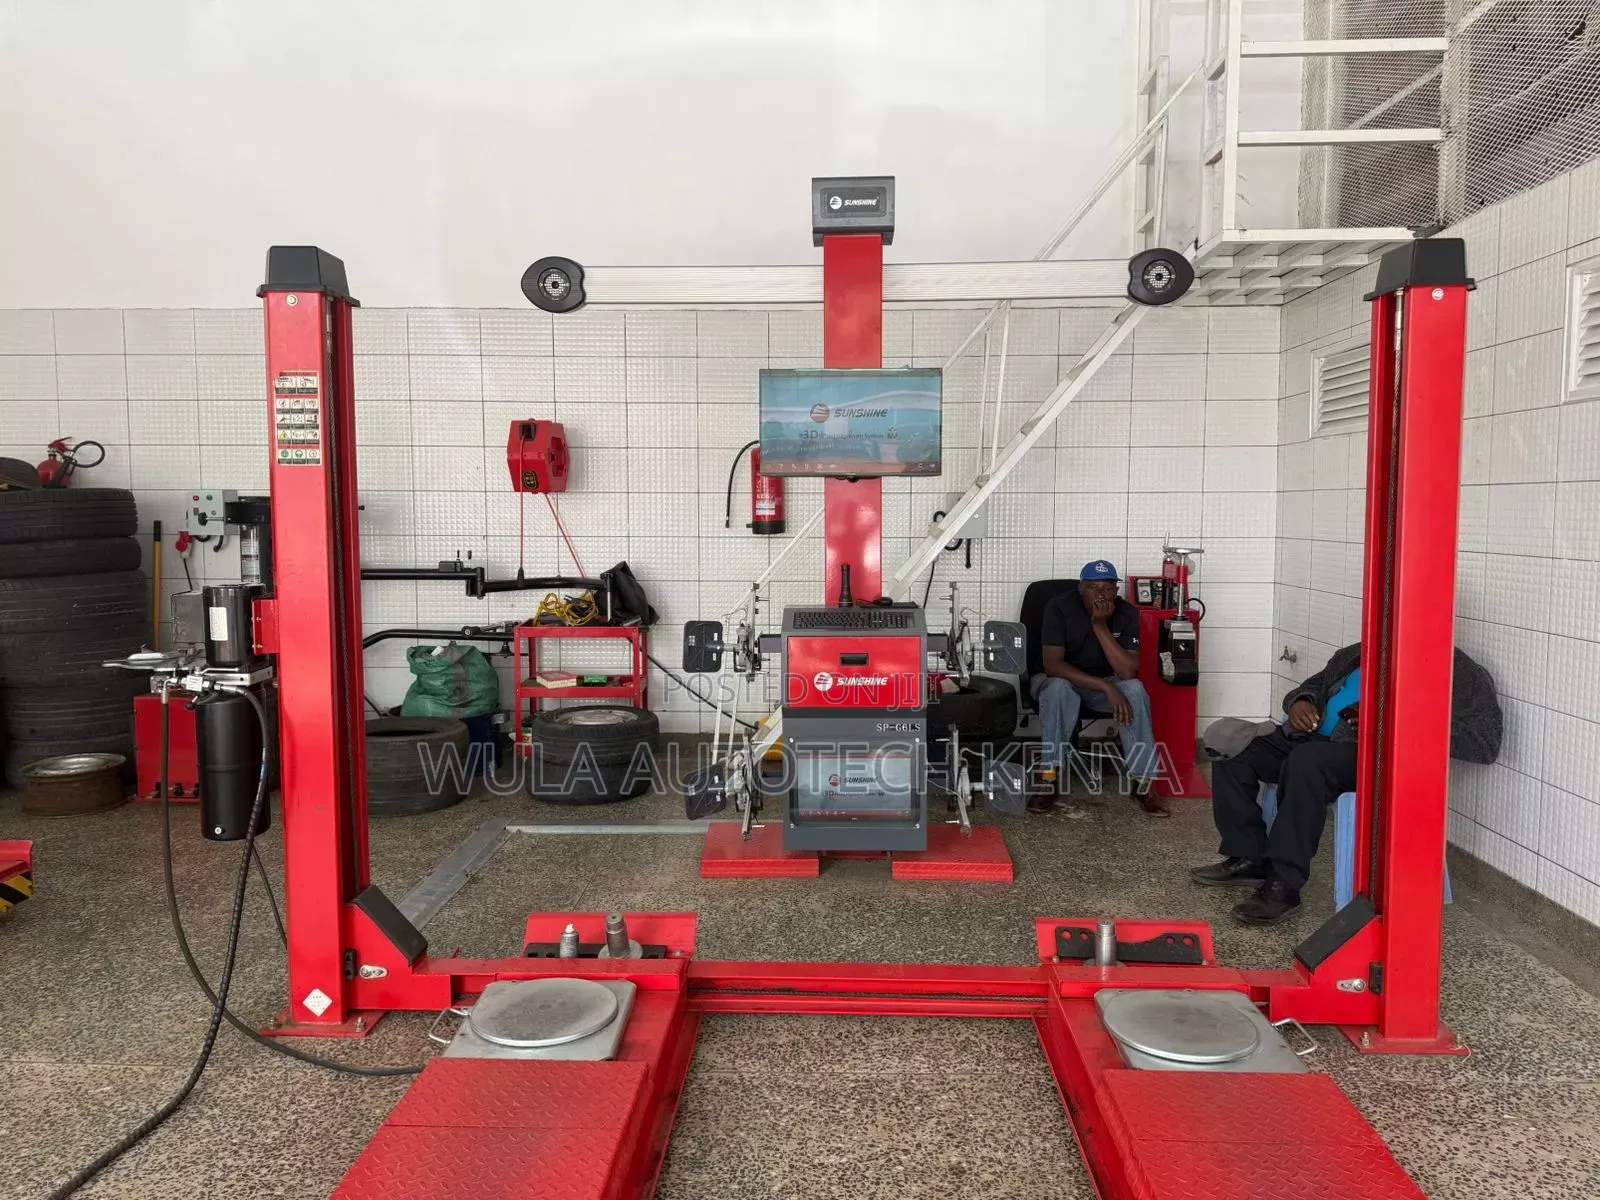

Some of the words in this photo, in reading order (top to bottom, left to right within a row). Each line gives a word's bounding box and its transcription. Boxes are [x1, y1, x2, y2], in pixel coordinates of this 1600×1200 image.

[833, 408, 888, 418] SUNSHINE
[803, 430, 819, 440] 3D
[836, 677, 889, 686] SUNSHINE
